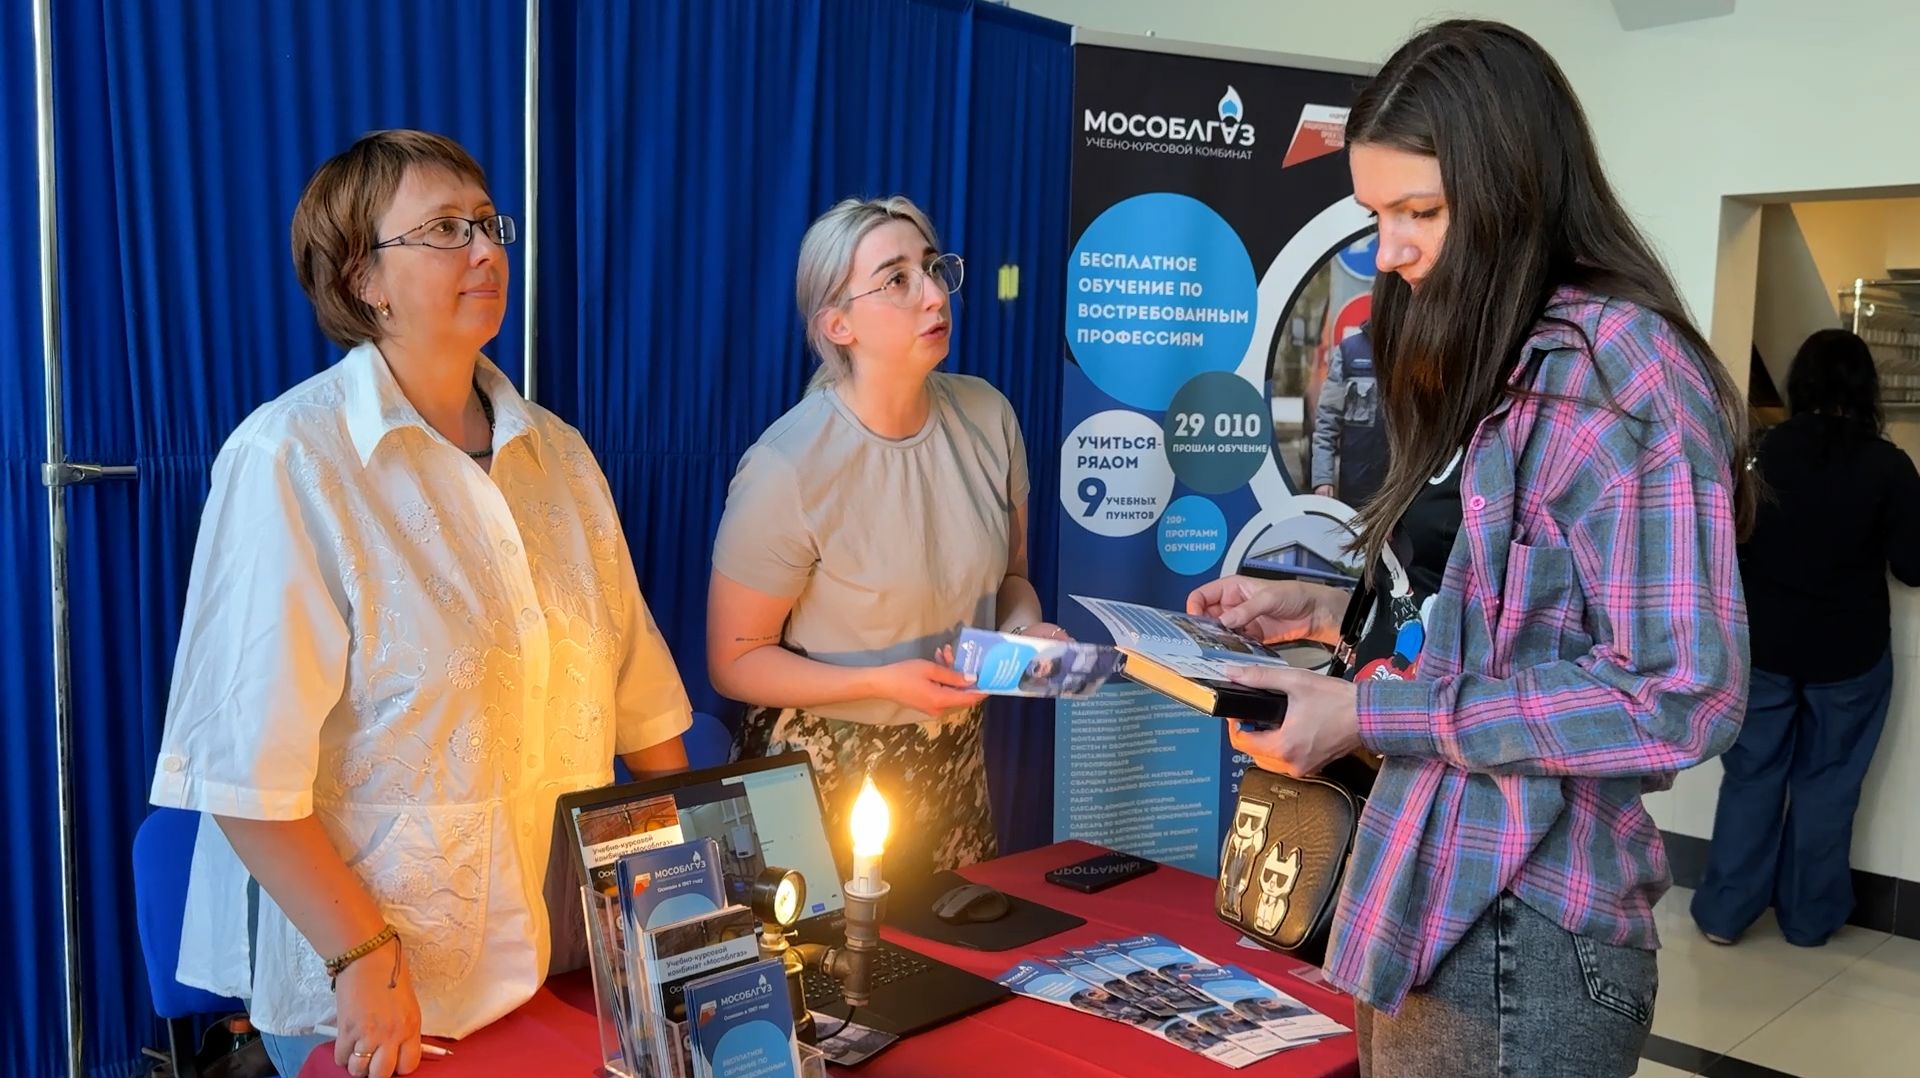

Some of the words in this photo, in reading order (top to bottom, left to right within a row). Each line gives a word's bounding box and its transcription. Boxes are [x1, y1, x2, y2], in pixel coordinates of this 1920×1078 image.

[1084, 109, 1255, 146] МОСОБЛГАЗ
[1086, 137, 1192, 155] УЧЕБНО-КУРСОВОЙ
[1195, 147, 1253, 160] КОМБИНАТ
[1079, 252, 1197, 271] БЕСПЛАТНОЕ
[1078, 277, 1174, 296] ОБУЧЕНИЕ
[1180, 280, 1202, 297] ПО
[1078, 303, 1249, 324] ВОСТРЕБОВАННЫМ
[1077, 328, 1203, 346] ПРОФЕССИЯМ
[1174, 412, 1205, 437] 29
[1214, 413, 1261, 437] 010
[1172, 443, 1215, 453] ПРОШЛИ
[1217, 443, 1268, 453] ОБУЧЕНИЕ
[1077, 455, 1138, 469] РЯДОМ
[1077, 477, 1107, 517] 9
[1106, 496, 1157, 506] УЧЕБНЫХ
[1106, 511, 1154, 520] ПУНКТОВ
[1165, 529, 1217, 539] ПРОГРАММ
[1164, 542, 1216, 552] ОБУЧЕНИЯ
[592, 835, 653, 855] Учебно-курсовой
[655, 860, 706, 879] МОСОБЛГАЗ
[721, 984, 773, 1006] МОСОБЛГАЗ
